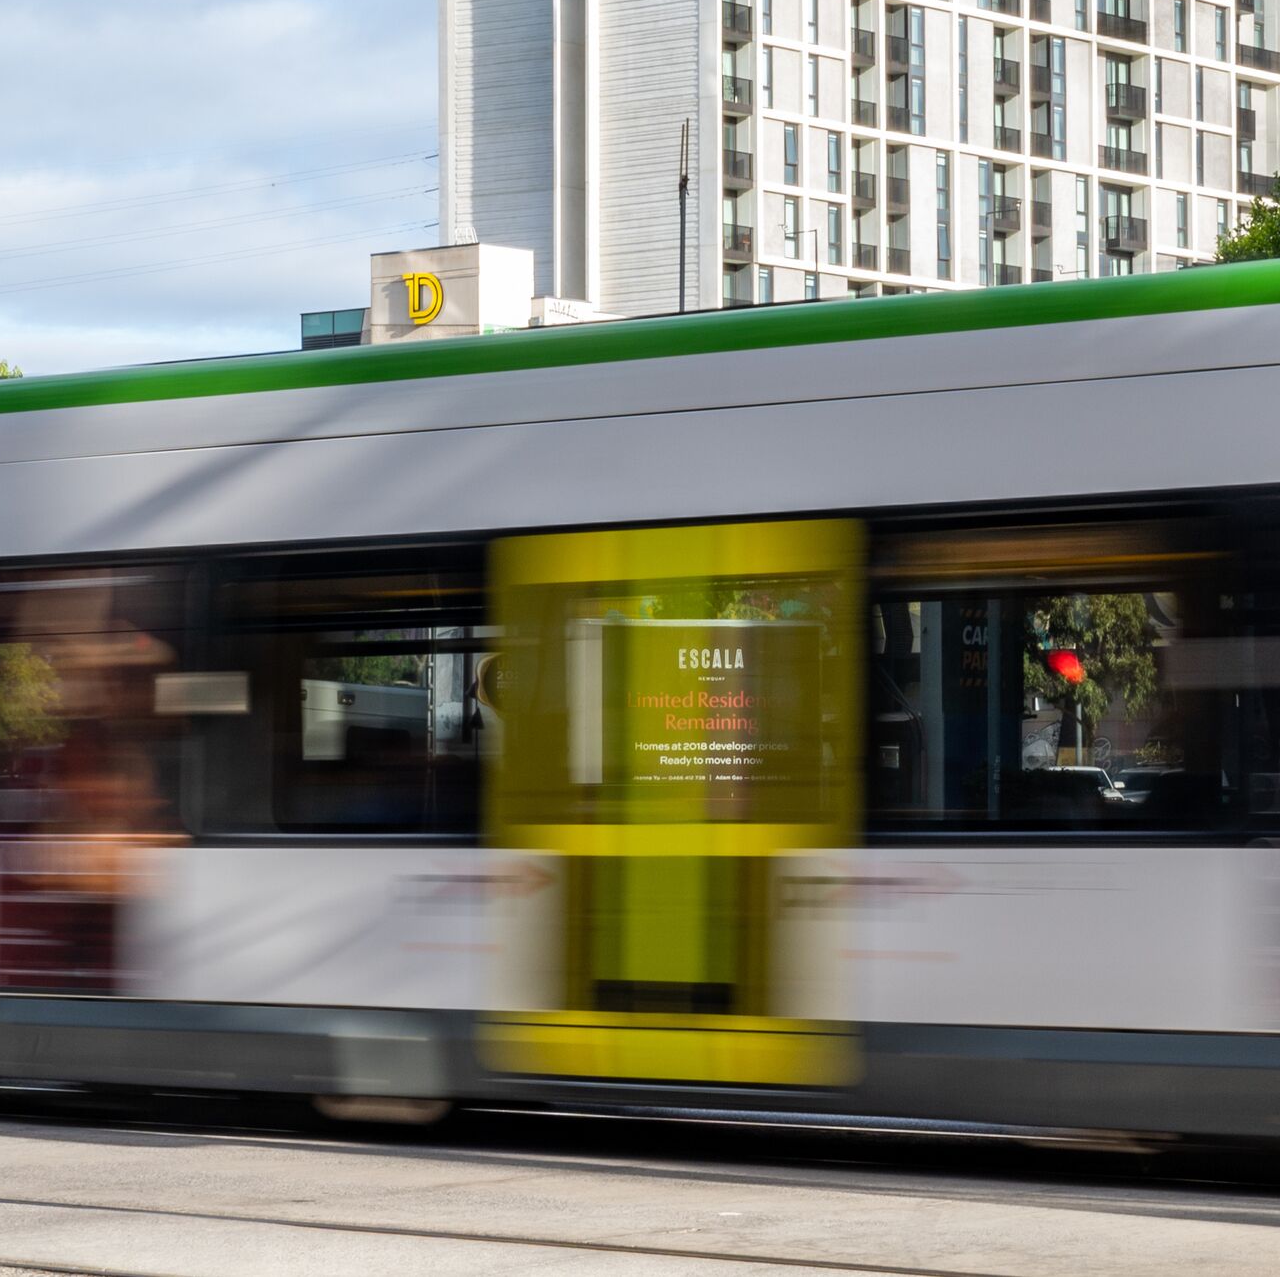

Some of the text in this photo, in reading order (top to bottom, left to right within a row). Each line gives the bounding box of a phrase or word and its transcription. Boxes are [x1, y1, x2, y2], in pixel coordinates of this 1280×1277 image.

[678, 648, 744, 669] ESCALA
[626, 691, 694, 708] Limited
[665, 714, 758, 734] Remaining
[634, 741, 670, 751] Homes
[671, 741, 682, 751] at
[683, 741, 708, 751] 2018
[709, 741, 757, 753] developer
[659, 755, 764, 767] Ready to move in now
